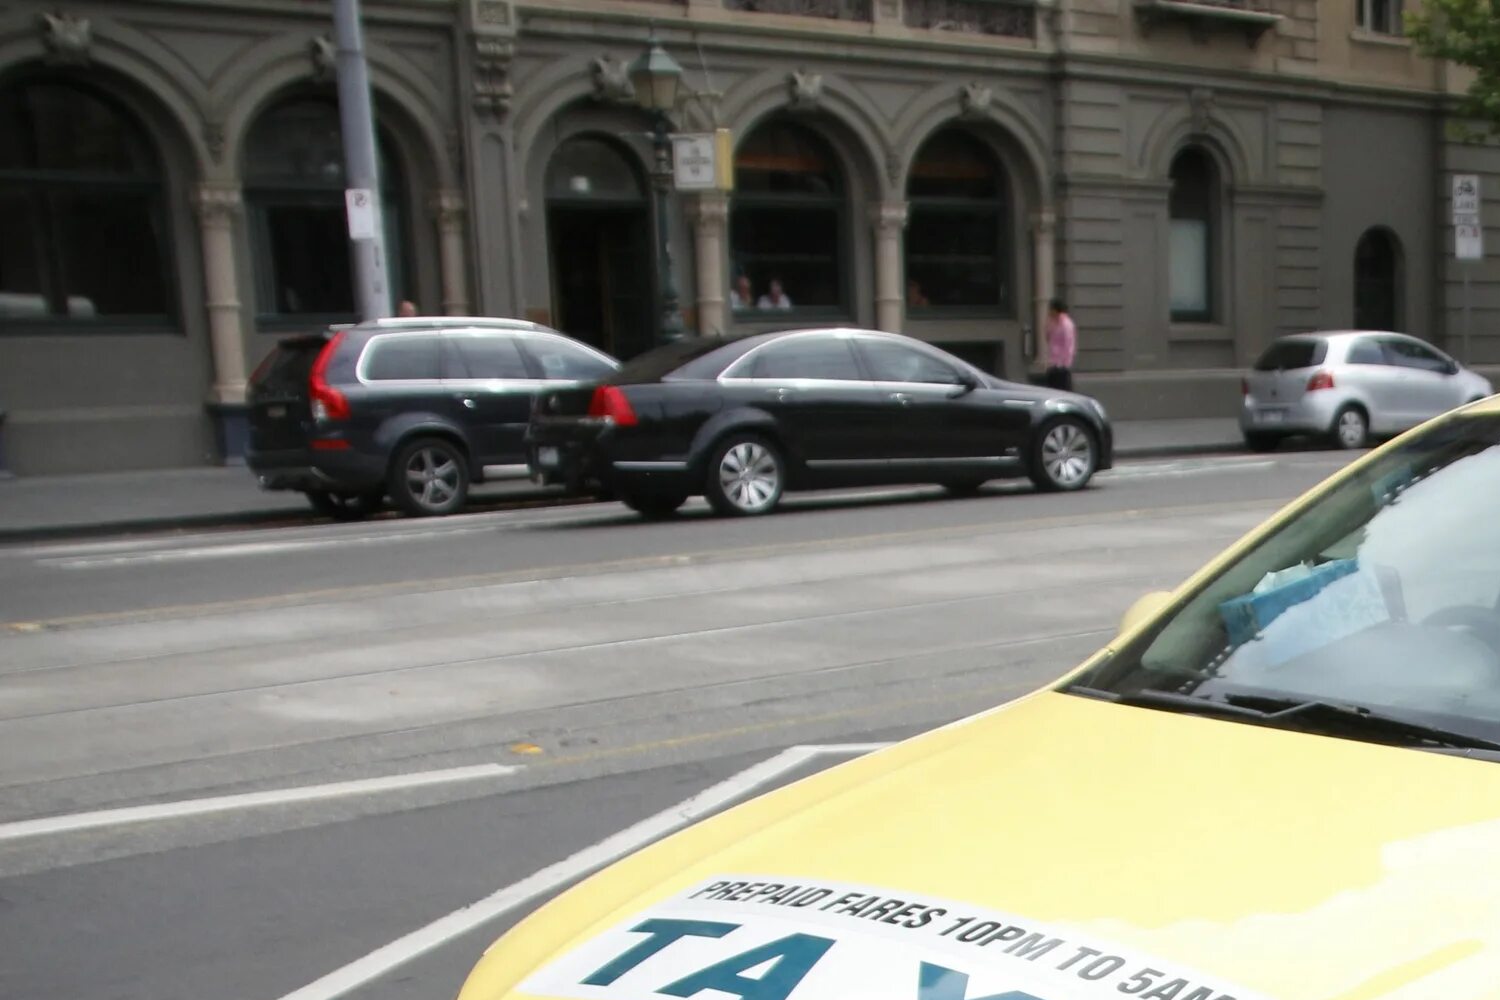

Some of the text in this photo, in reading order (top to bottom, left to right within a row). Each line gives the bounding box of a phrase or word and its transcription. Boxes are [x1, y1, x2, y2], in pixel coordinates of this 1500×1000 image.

[688, 880, 833, 911] PREPAID
[821, 892, 946, 930] FARES
[939, 915, 1065, 962] 10PM
[1056, 933, 1126, 981] TO
